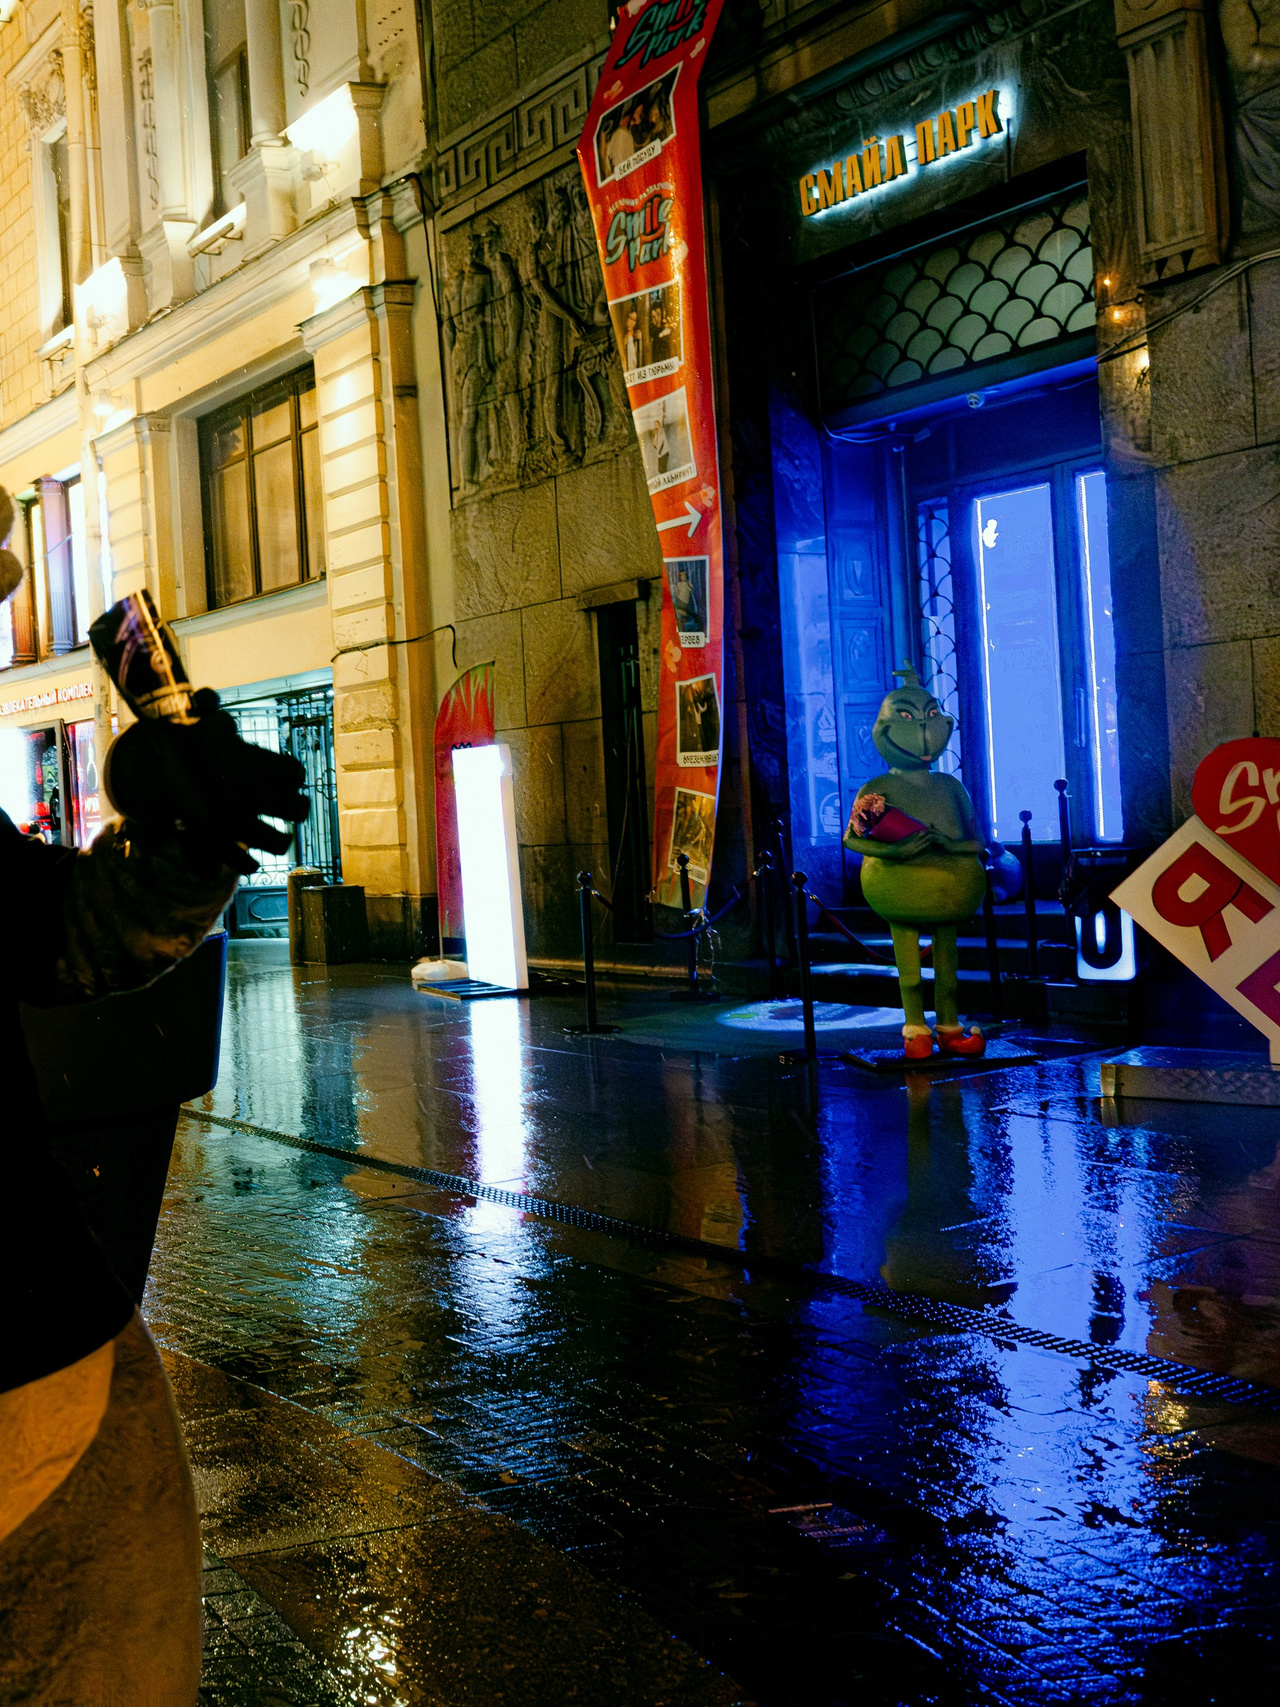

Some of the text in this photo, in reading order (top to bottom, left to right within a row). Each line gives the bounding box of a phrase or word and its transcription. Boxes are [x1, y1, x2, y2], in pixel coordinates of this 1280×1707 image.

[799, 89, 1003, 216] СМАЙЛ ПАРК
[604, 195, 675, 266] Smile
[58, 682, 94, 704] КОМПЛЕК
